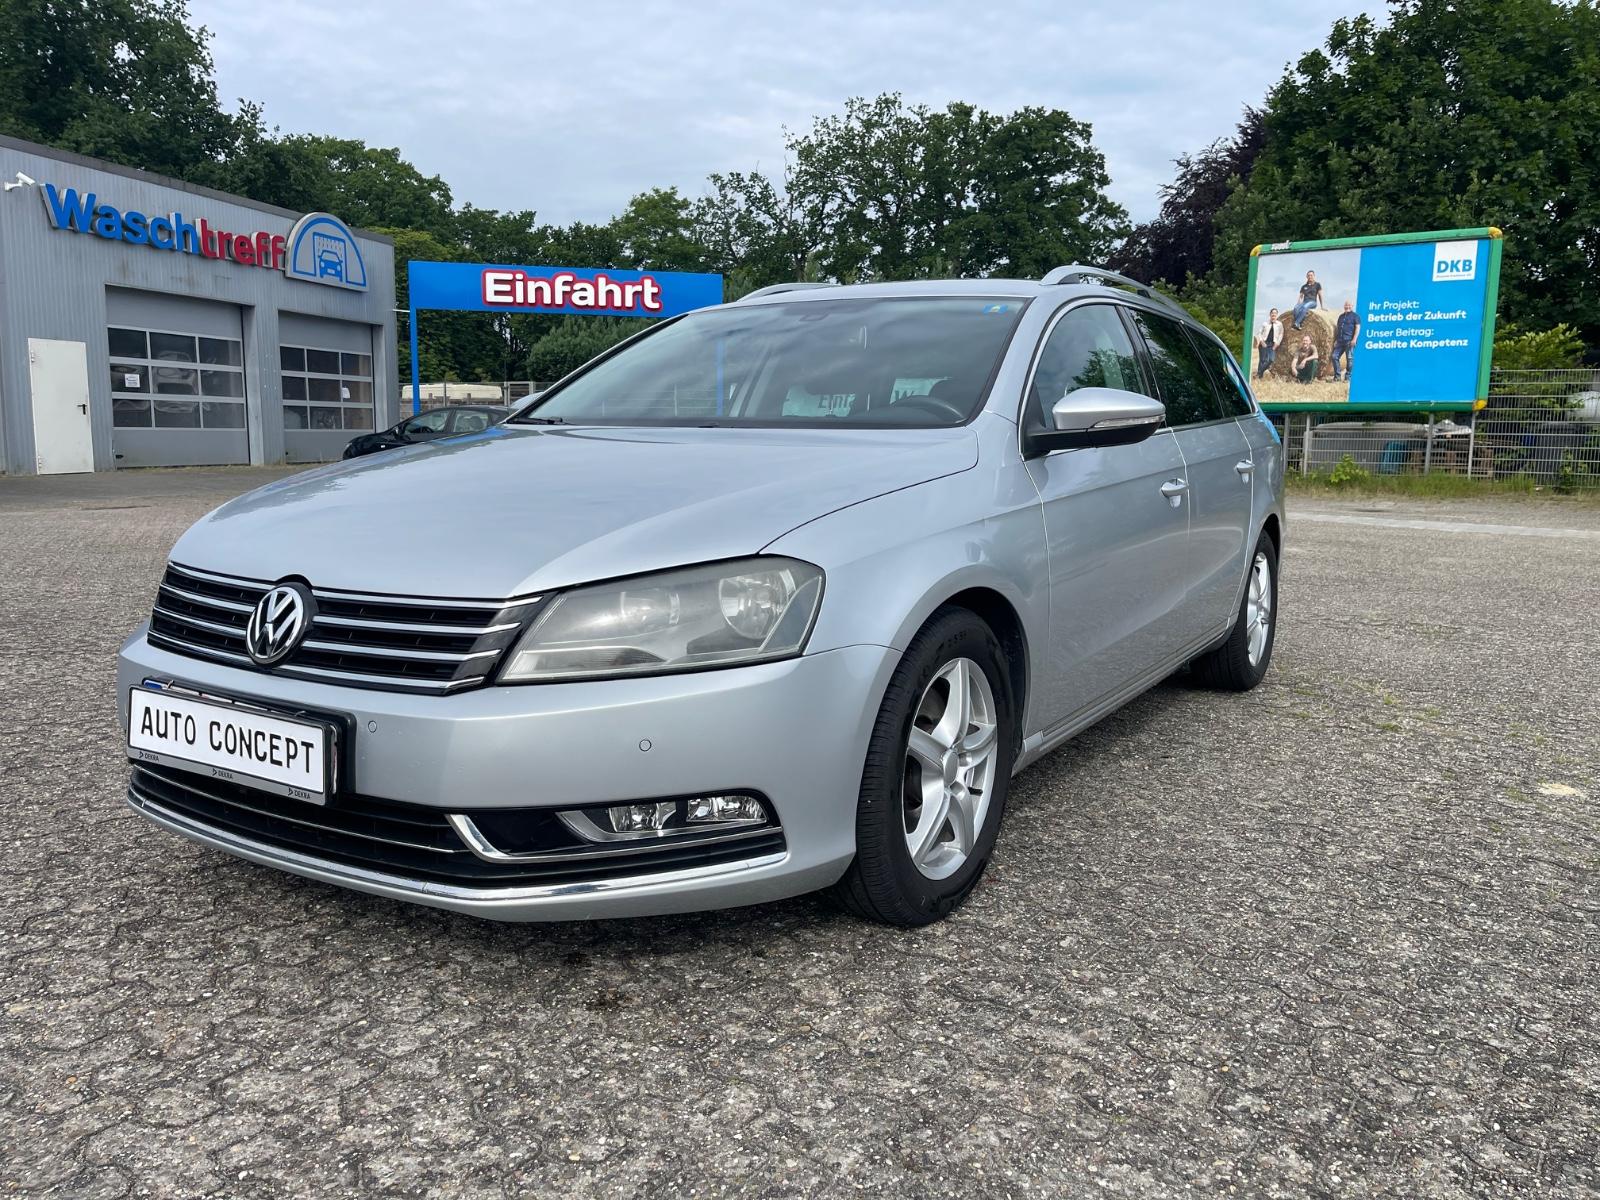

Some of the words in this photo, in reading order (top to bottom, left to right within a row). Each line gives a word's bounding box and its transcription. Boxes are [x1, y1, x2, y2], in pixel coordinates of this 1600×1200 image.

[42, 183, 286, 270] Waschtreff
[1437, 259, 1473, 273] DKB
[484, 271, 660, 309] Einfahrt
[1369, 301, 1381, 310] Ihr
[1383, 300, 1420, 311] Projekt:
[1367, 312, 1404, 322] Betrieb
[1405, 311, 1422, 321] der
[1424, 310, 1467, 320] Zukunft
[1366, 329, 1393, 338] Unser
[1396, 327, 1435, 338] Beitrag:
[1365, 340, 1408, 349] Geballte
[1409, 338, 1469, 349] Kompetenz
[141, 706, 197, 746] AUTO
[209, 720, 315, 774] CONCEPT
[144, 752, 160, 763] DEKRA
[217, 769, 234, 780] DEKRA
[293, 788, 312, 801] DEKRA
